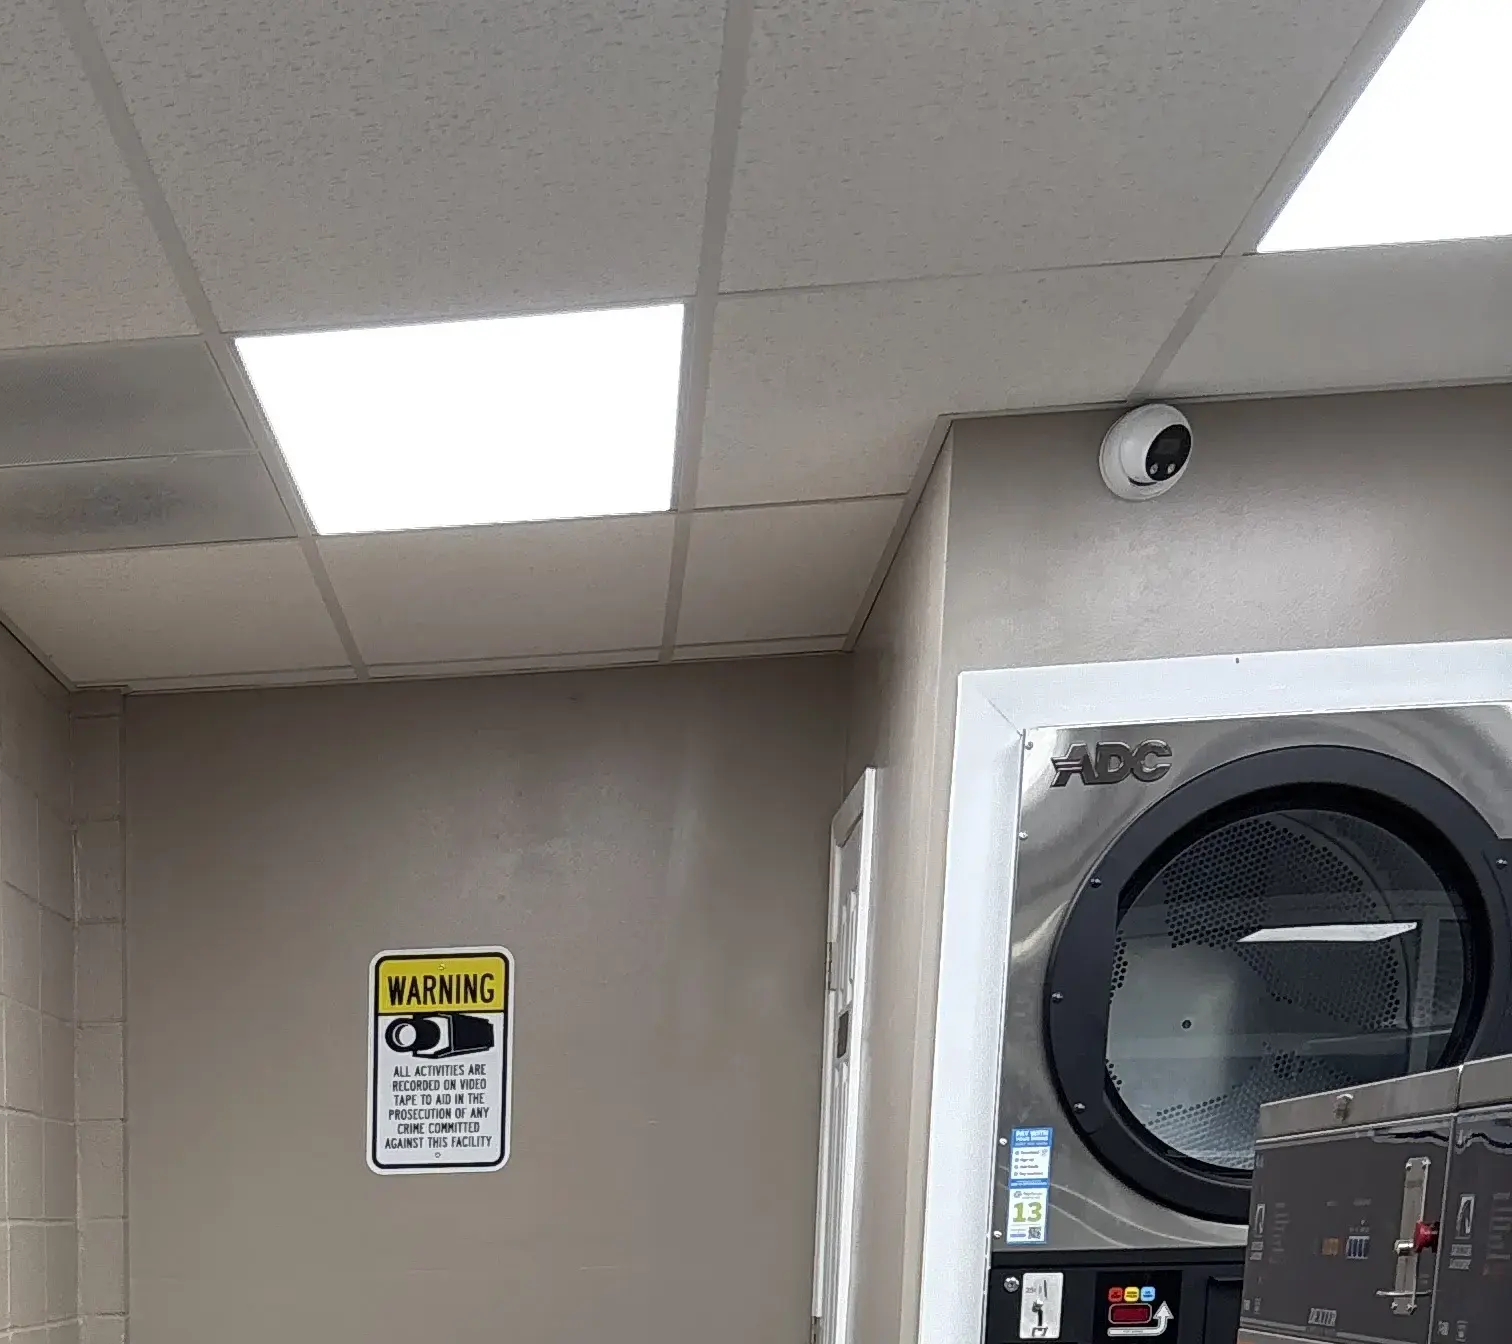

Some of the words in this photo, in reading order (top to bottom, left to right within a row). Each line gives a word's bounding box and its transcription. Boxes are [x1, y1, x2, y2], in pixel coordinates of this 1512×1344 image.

[1050, 739, 1172, 787] ADC
[387, 973, 495, 1007] WARNING
[393, 1066, 411, 1077] ALL
[414, 1064, 465, 1077] ACTIVITIES
[468, 1064, 486, 1075] ARE
[392, 1080, 440, 1092] RECORDED
[443, 1079, 456, 1090] ON
[460, 1078, 487, 1090] VIDEO
[394, 1094, 417, 1106] TAPE
[420, 1094, 432, 1105] TO
[435, 1093, 451, 1105] AID
[455, 1093, 464, 1105] IN
[468, 1092, 485, 1104] THE
[388, 1108, 451, 1120] PROSECUTION
[455, 1107, 467, 1119] OF
[470, 1107, 489, 1118] ANY
[397, 1122, 425, 1134] CRIME
[428, 1121, 480, 1134] COMMITTED
[385, 1137, 424, 1149] AGAINST
[427, 1136, 448, 1148] THIS
[451, 1135, 492, 1148] FACILITY
[1013, 1201, 1042, 1222] 13
